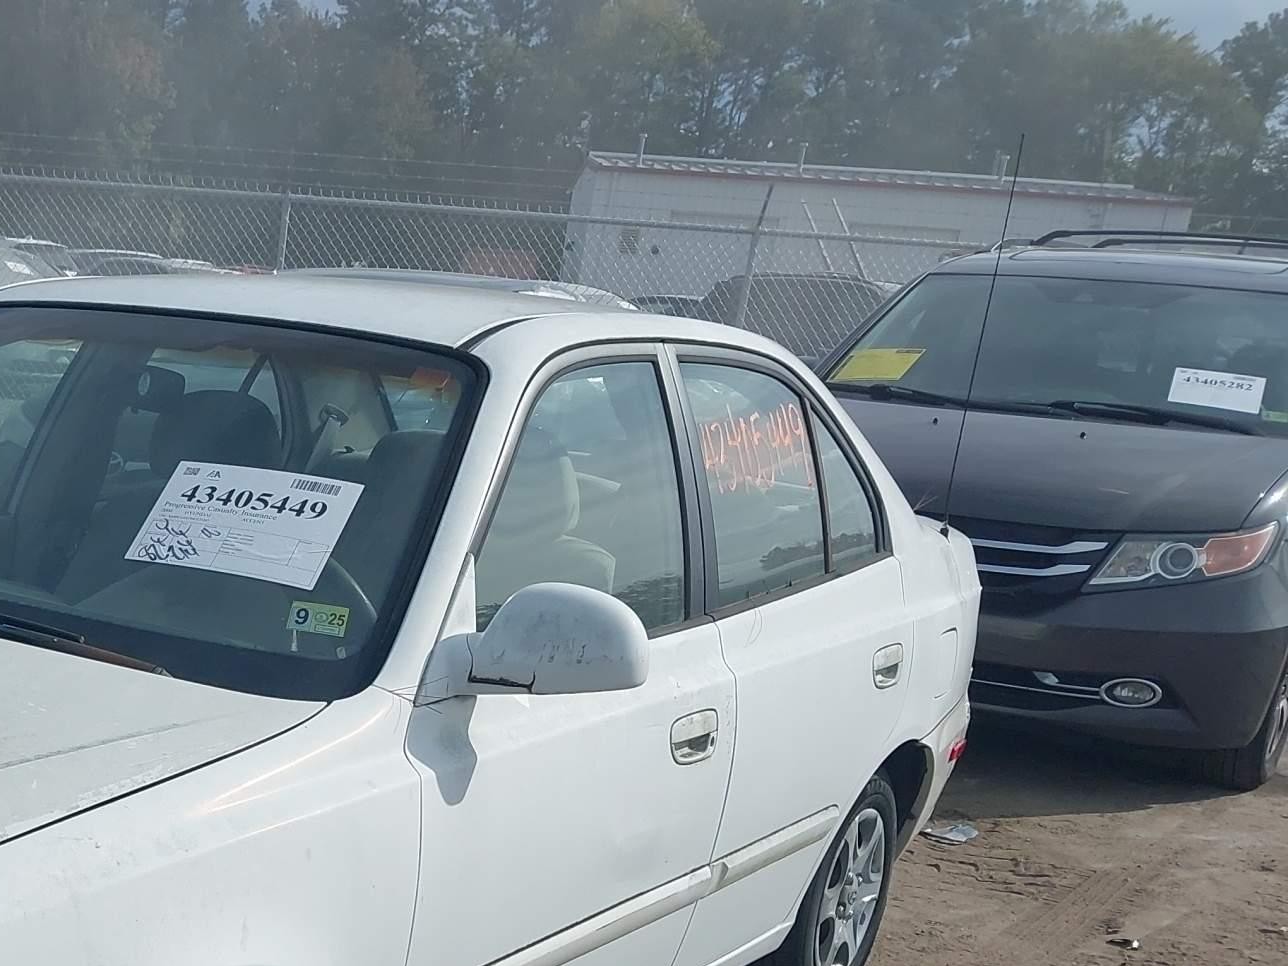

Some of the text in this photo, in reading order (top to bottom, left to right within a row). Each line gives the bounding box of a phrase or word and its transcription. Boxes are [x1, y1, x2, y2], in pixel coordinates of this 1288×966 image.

[163, 501, 208, 512] Progressive
[207, 506, 238, 515] Casualty
[241, 509, 278, 521] Insurance
[180, 484, 328, 520] 43405449
[294, 608, 346, 627] 9 25
